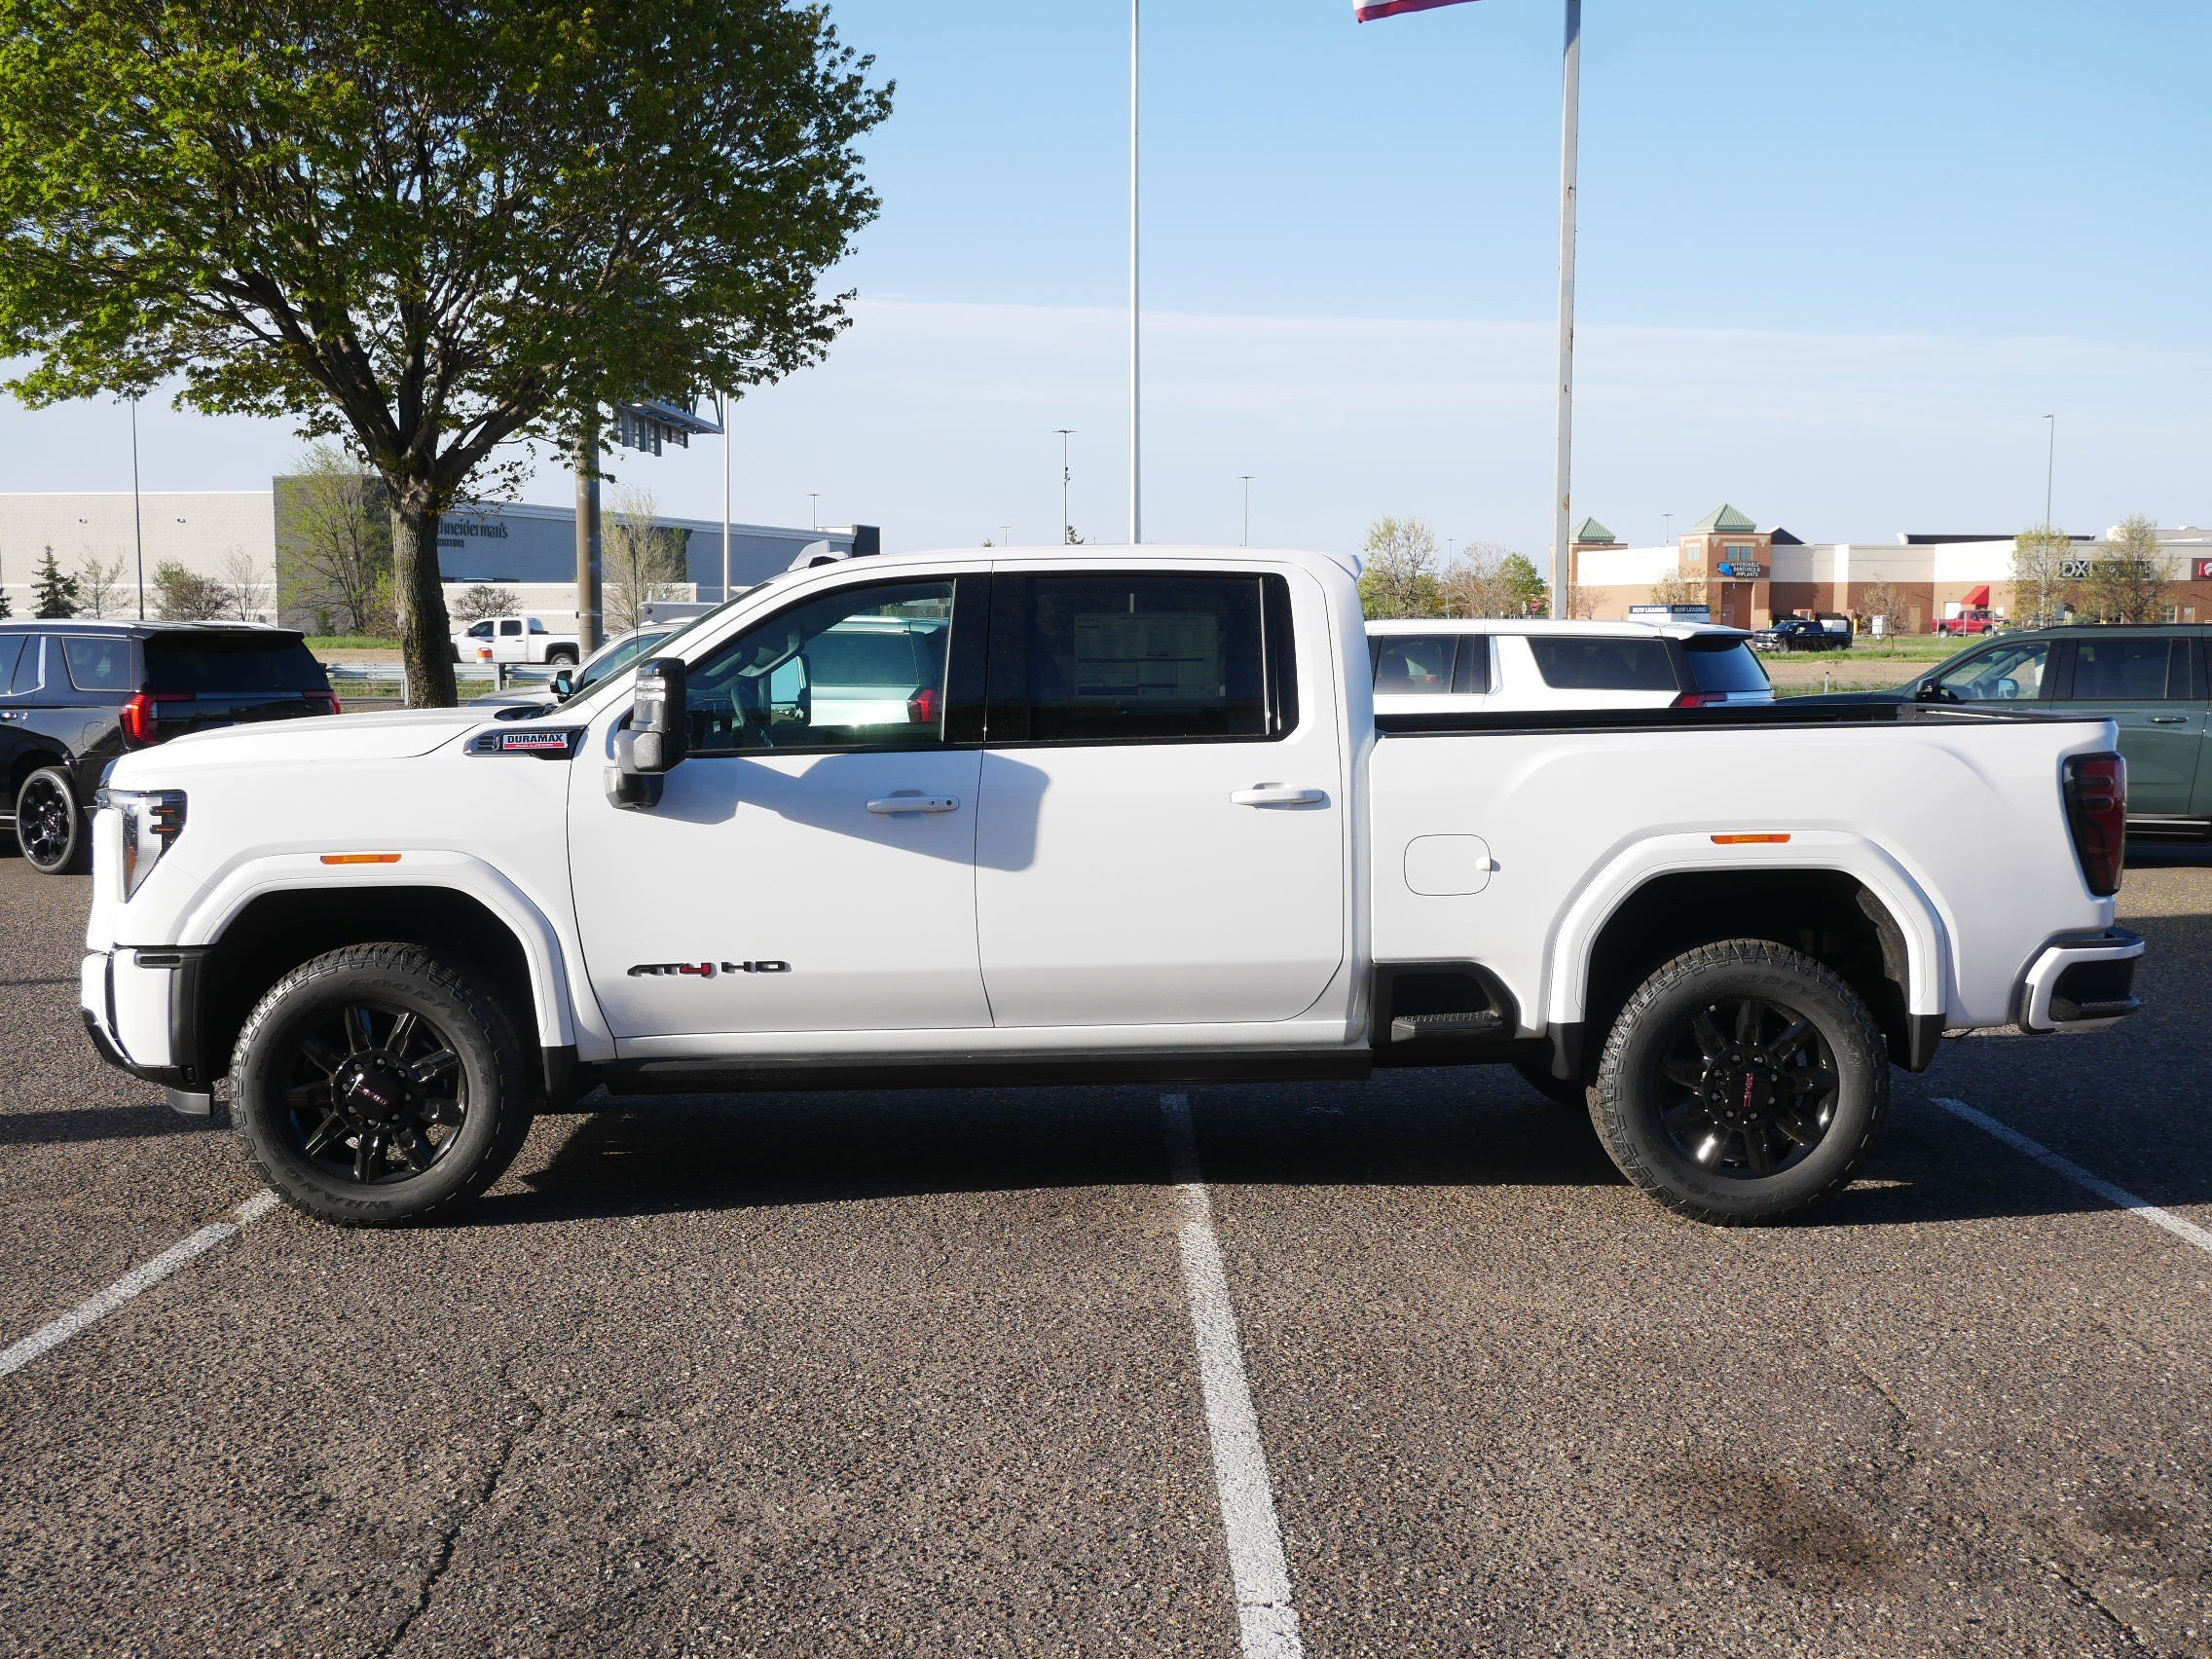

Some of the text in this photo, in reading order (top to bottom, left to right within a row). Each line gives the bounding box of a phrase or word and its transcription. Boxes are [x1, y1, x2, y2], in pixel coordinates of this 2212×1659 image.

[440, 518, 508, 539] hneiderman's
[507, 734, 563, 744] DURAMAX
[720, 960, 787, 974] HD
